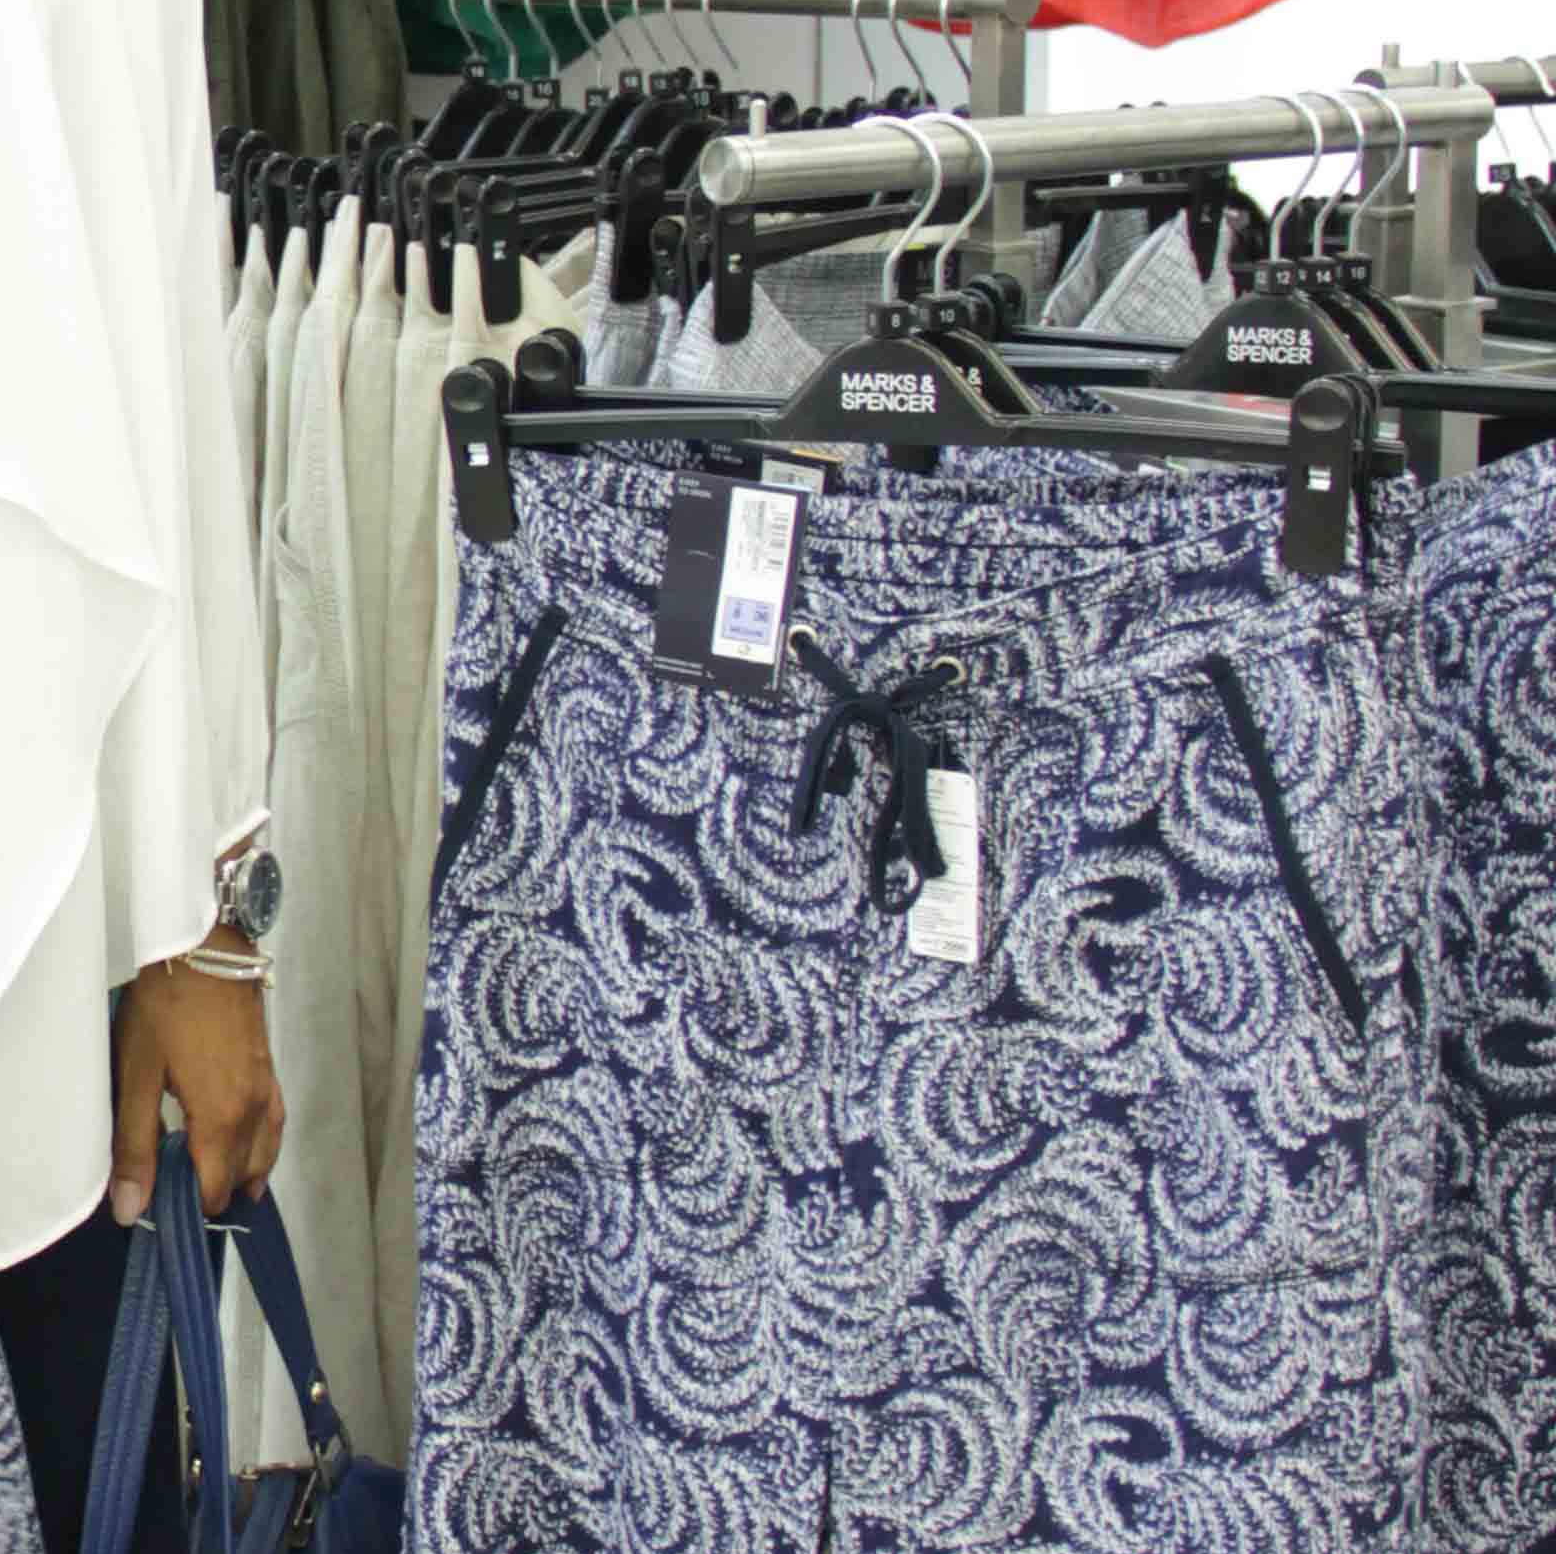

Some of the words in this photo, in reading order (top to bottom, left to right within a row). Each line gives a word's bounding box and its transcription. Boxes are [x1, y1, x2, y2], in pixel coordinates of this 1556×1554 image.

[1276, 270, 1291, 286] 12
[1315, 269, 1332, 283] 14
[940, 308, 955, 323] 10
[1227, 326, 1295, 347] MARKS
[1298, 329, 1313, 347] &
[1227, 345, 1313, 366] SPENCER
[841, 372, 918, 393] MARKS
[919, 374, 936, 394] &
[841, 391, 937, 413] SPENCER
